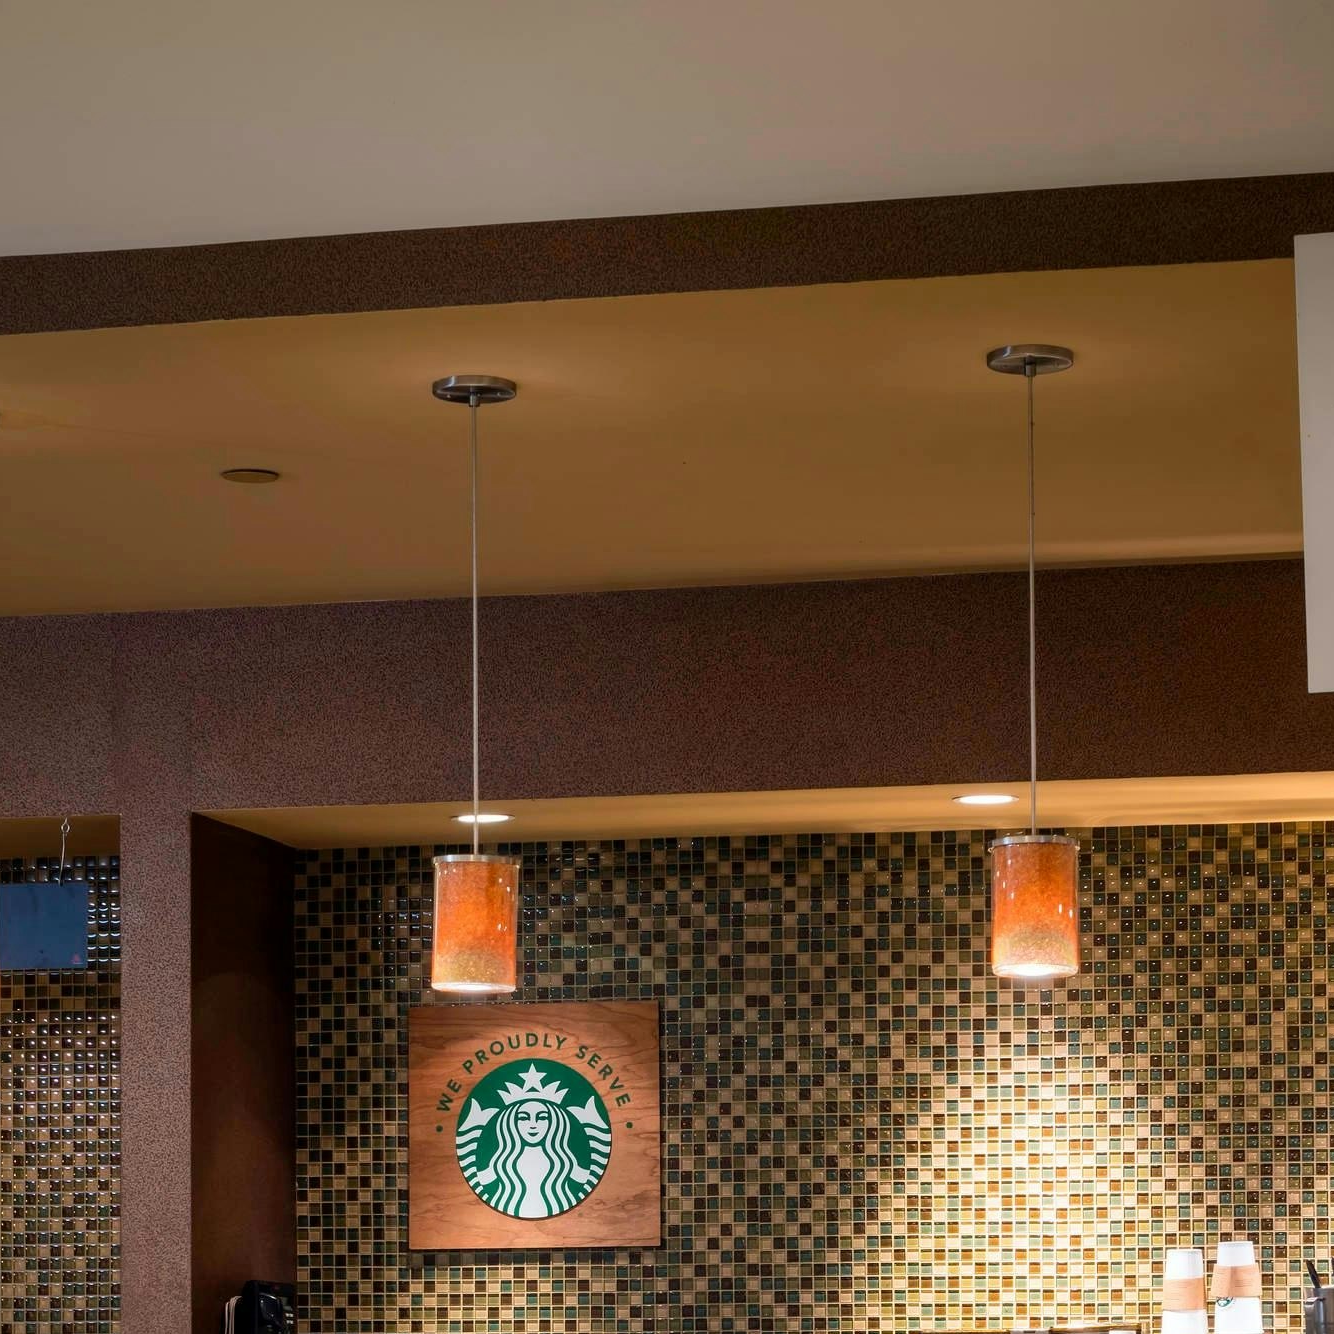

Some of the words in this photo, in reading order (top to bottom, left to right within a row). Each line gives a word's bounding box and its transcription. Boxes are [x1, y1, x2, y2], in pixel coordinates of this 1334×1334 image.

[436, 1079, 462, 1112] WE
[462, 1032, 567, 1074] PROUDLY
[575, 1045, 631, 1108] SERVE
